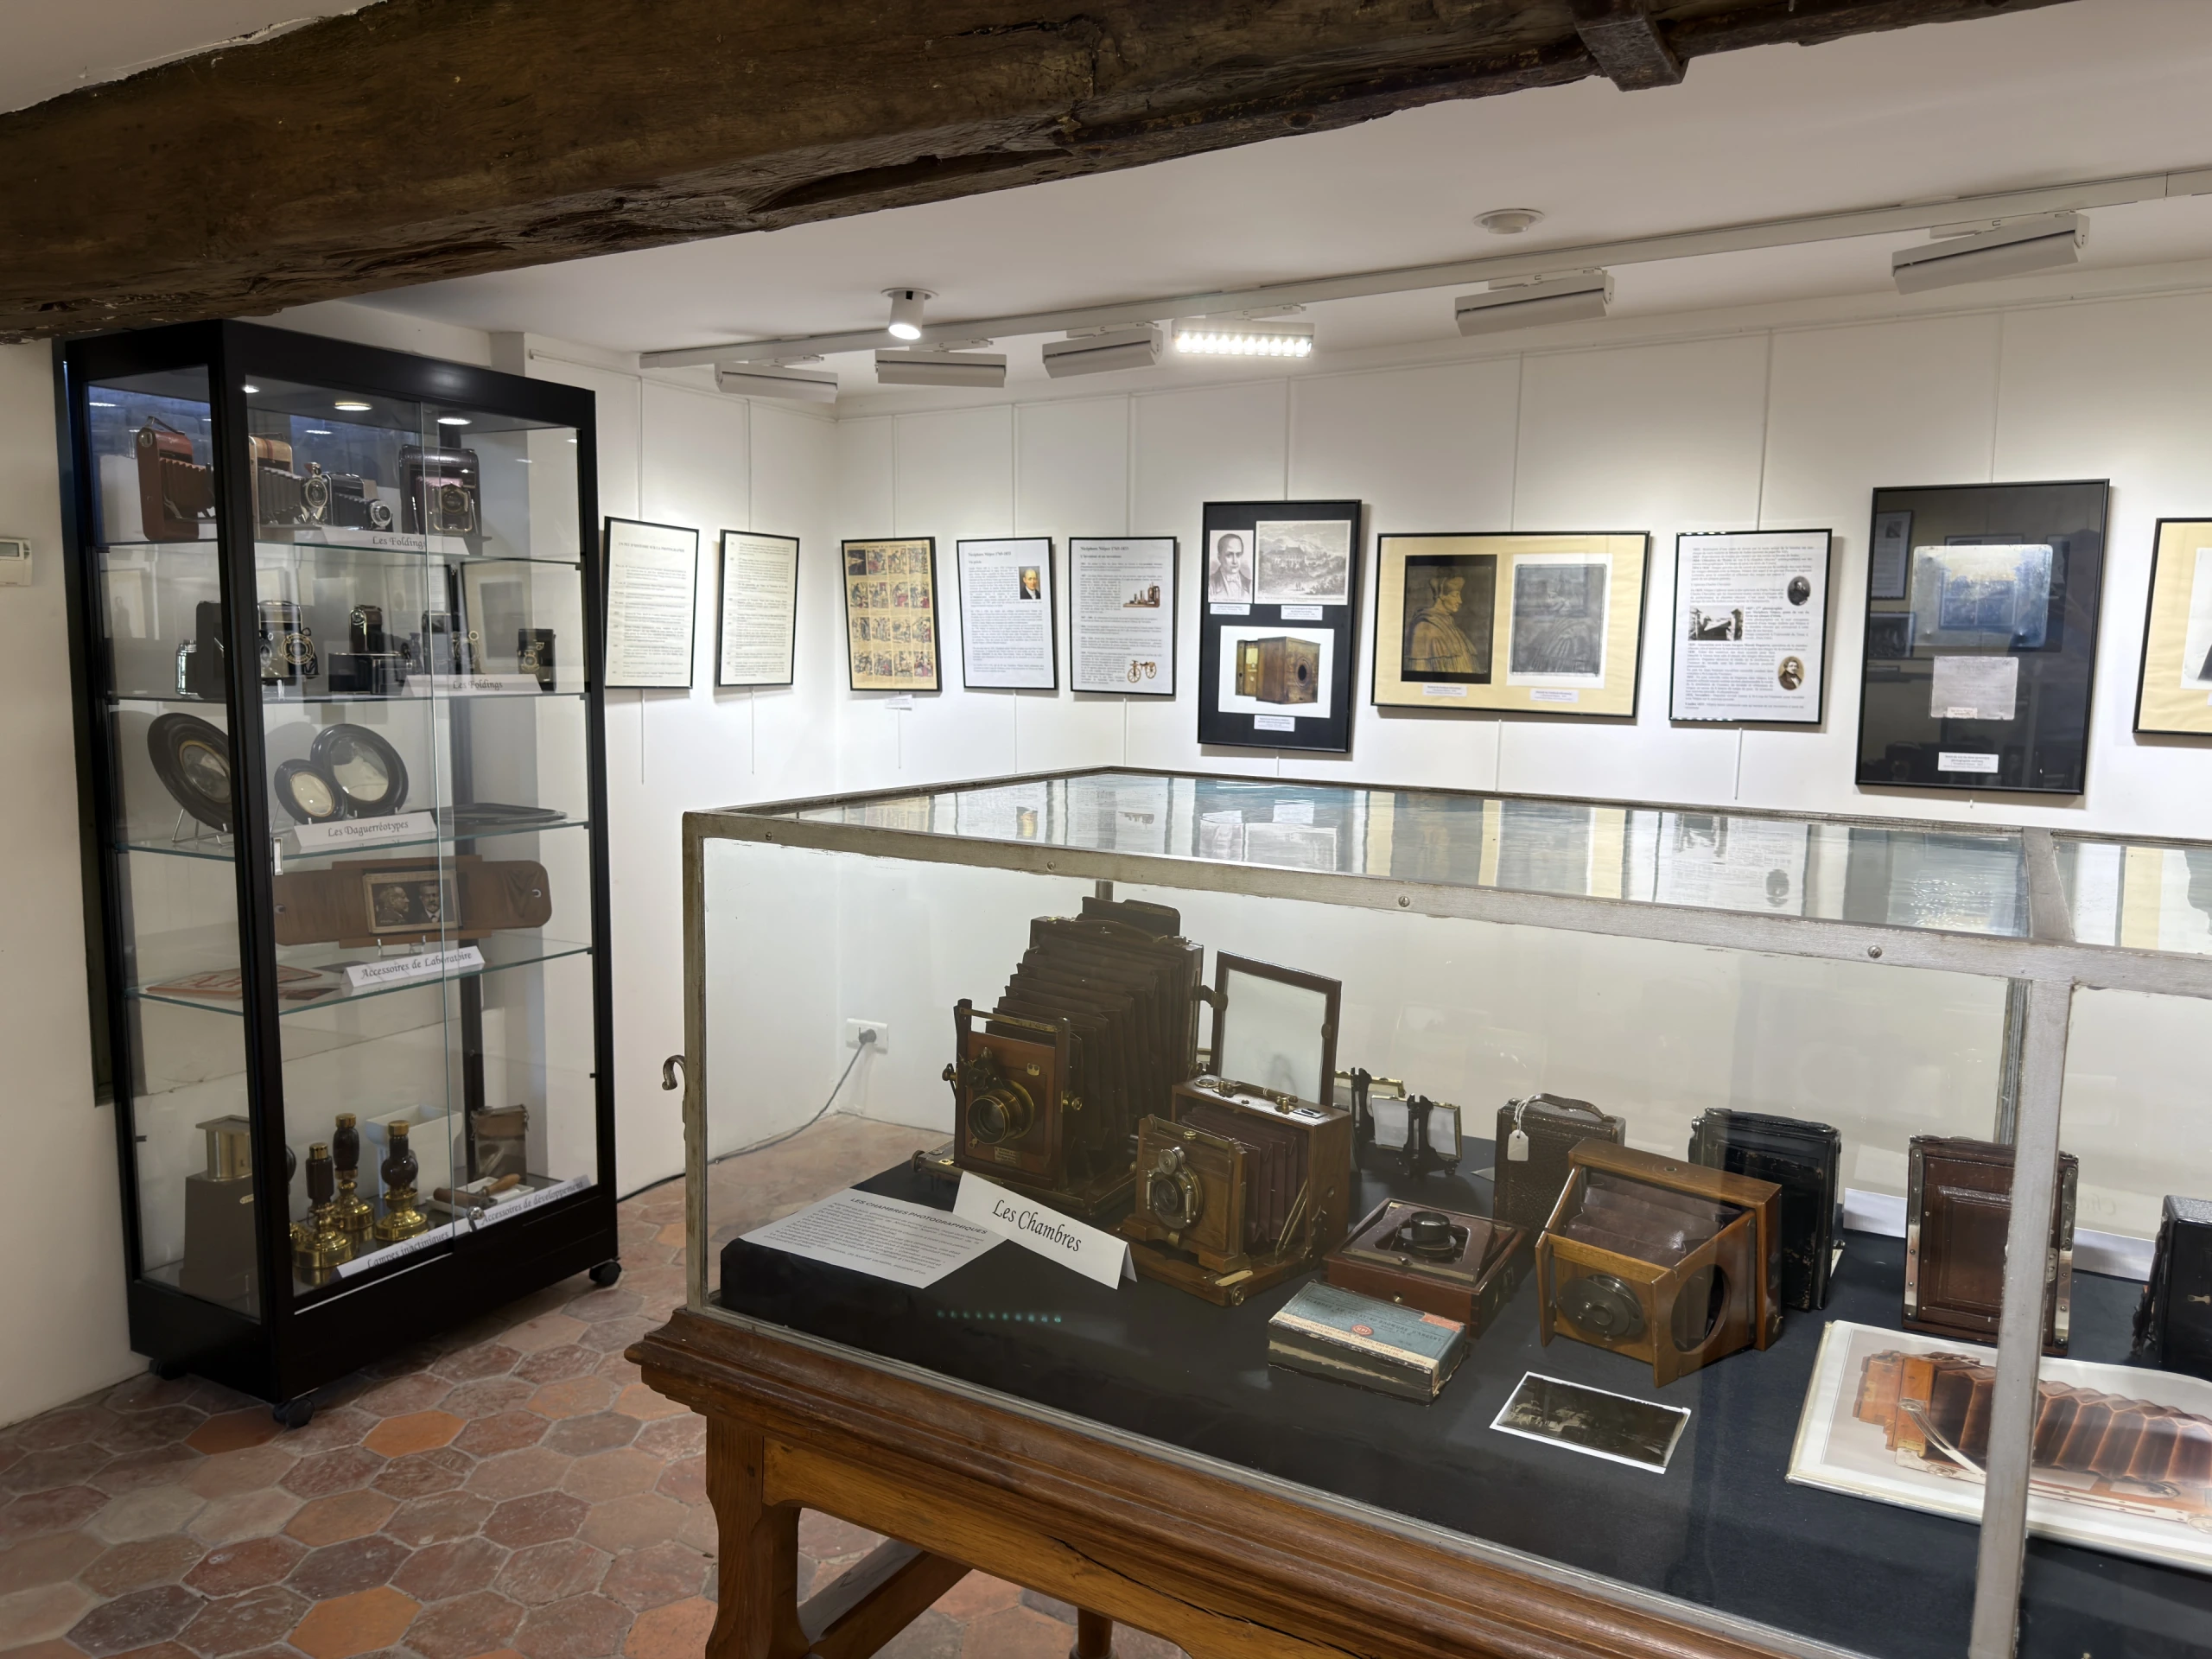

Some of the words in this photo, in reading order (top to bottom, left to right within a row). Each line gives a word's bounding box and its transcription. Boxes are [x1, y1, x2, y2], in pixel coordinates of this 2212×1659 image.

[372, 537, 387, 545] Les
[453, 681, 467, 690] Les
[468, 679, 503, 691] Foldings
[328, 828, 342, 836] Les
[344, 821, 409, 836] Daguerréotypes
[361, 963, 410, 980] Accessoires
[412, 959, 422, 969] de
[480, 1205, 522, 1225] Accessoires
[524, 1199, 532, 1209] de
[866, 1202, 908, 1215] CHAMBRES
[908, 1211, 988, 1234] PHOTOGRAPHIQUES
[992, 1199, 1016, 1222] Les
[1018, 1211, 1082, 1252] Chambres
